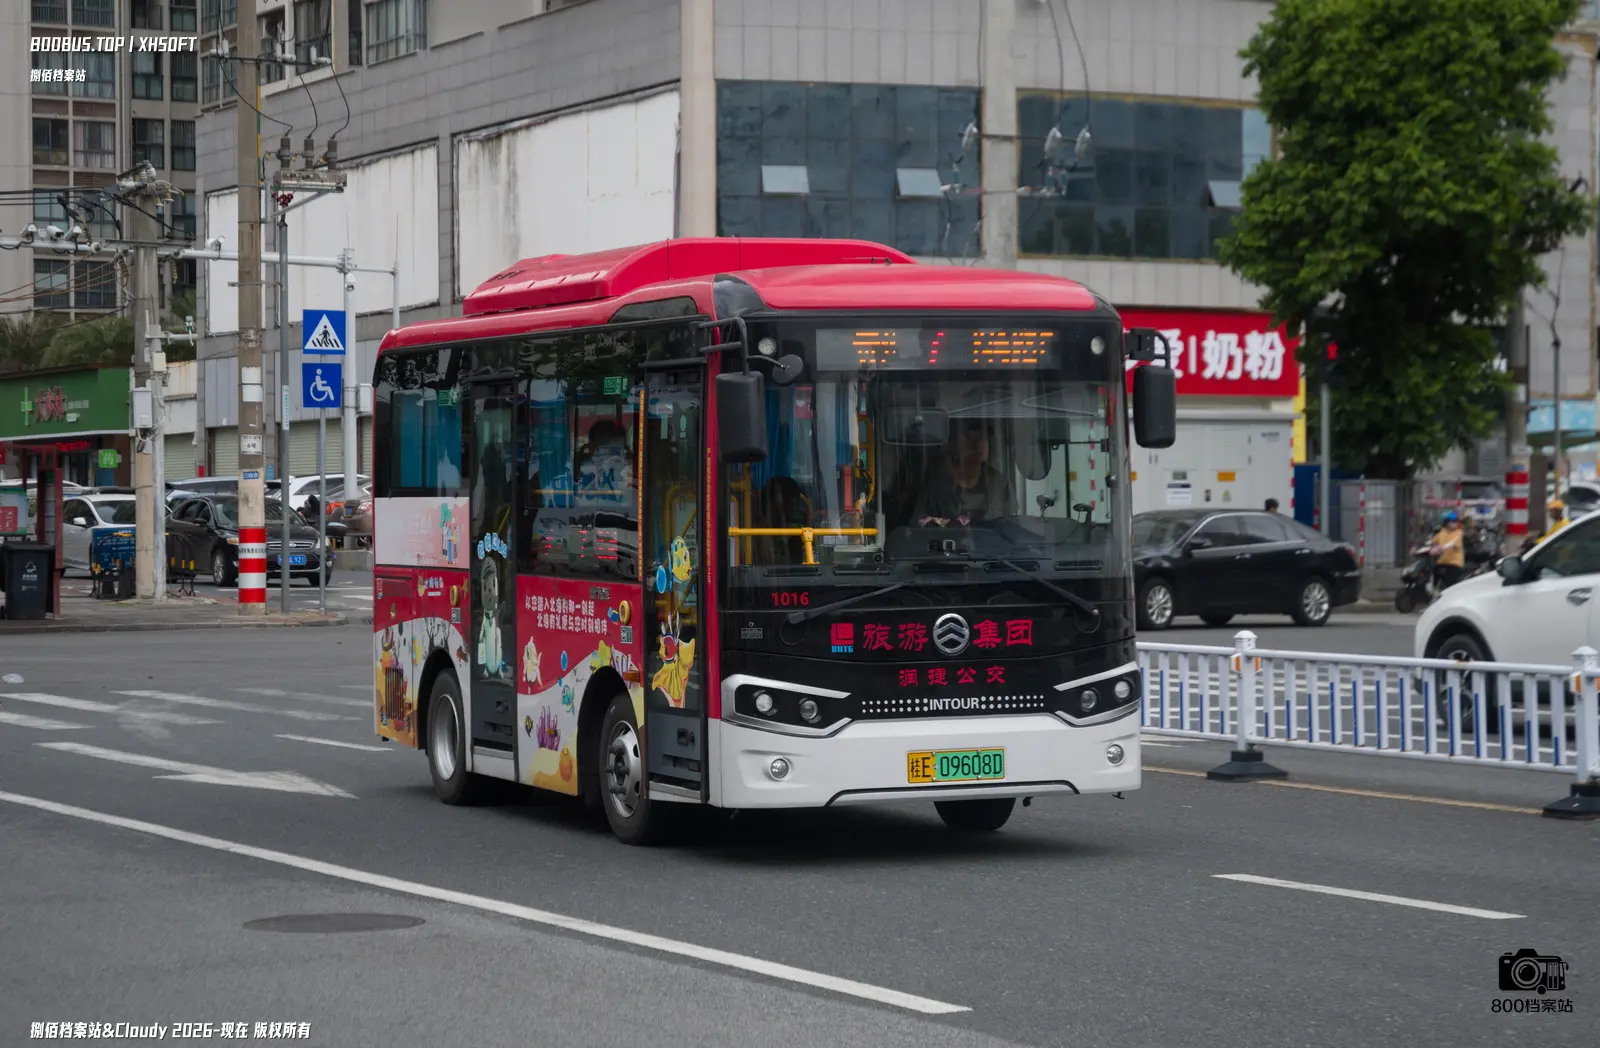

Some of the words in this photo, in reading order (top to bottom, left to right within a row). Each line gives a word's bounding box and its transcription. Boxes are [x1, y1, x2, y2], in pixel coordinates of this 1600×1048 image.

[1202, 330, 1286, 380] 奶粉
[771, 592, 810, 606] 1016
[863, 623, 929, 651] 旅游
[973, 619, 1034, 648] 集团
[899, 665, 1005, 687] 润捷公交
[929, 697, 980, 711] INTOUR
[910, 756, 932, 778] 桂E
[940, 753, 1003, 778] 09608D
